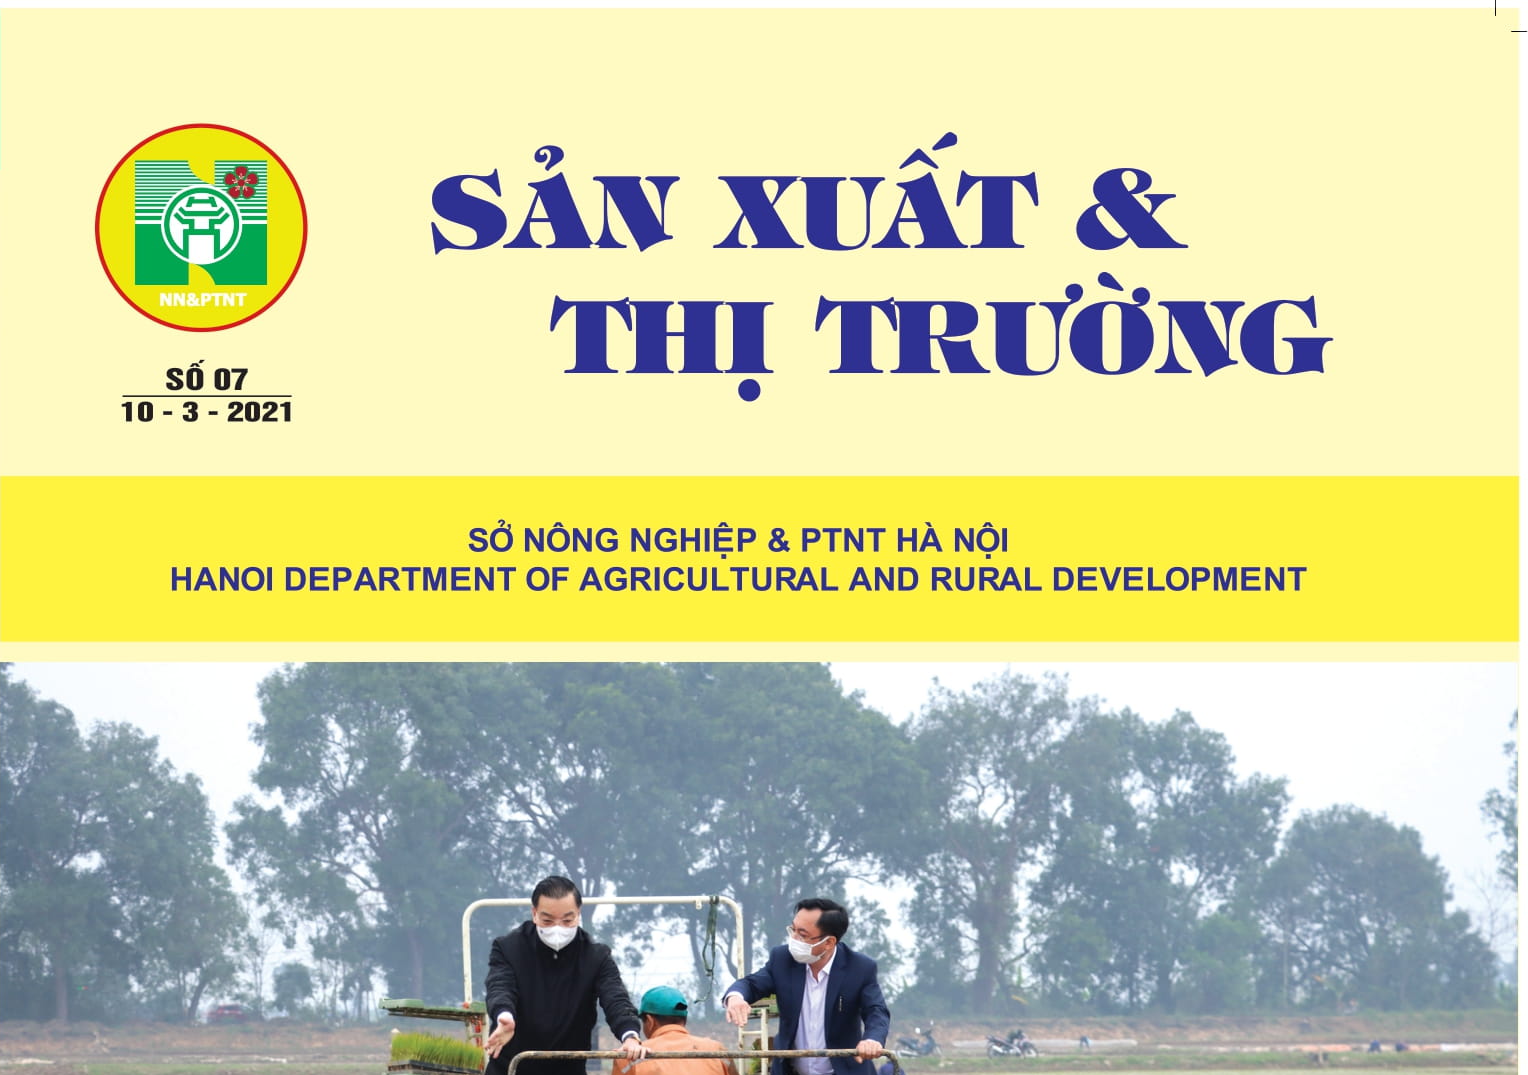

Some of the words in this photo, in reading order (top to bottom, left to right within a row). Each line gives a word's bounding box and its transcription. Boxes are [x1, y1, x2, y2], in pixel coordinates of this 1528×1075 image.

[431, 146, 680, 254] SẢN
[713, 132, 1038, 250] XUẤT
[1077, 168, 1188, 250] &
[159, 292, 247, 307] NN&PTNT
[550, 296, 773, 401] THỊ
[815, 272, 1333, 376] TRƯỜNG
[166, 360, 204, 390] SỐ
[215, 368, 248, 390] 07
[122, 402, 153, 422] 10
[183, 402, 198, 422] 3
[228, 402, 291, 422] 2021
[469, 520, 513, 552] SỞ
[525, 522, 618, 552] NÔNG
[632, 522, 756, 559] NGHIỆP
[769, 528, 790, 552] &
[802, 528, 885, 552] PTNT
[898, 522, 942, 552] HÀ
[955, 522, 1007, 559] NỘI
[172, 567, 272, 591] HANOI
[286, 567, 516, 590] DEPARTMENT
[527, 567, 569, 591] OF
[580, 567, 838, 591] AGRICULTURAL
[849, 567, 918, 590] AND
[932, 567, 1042, 591] RURAL
[1054, 567, 1306, 591] DEVELOPMENT
